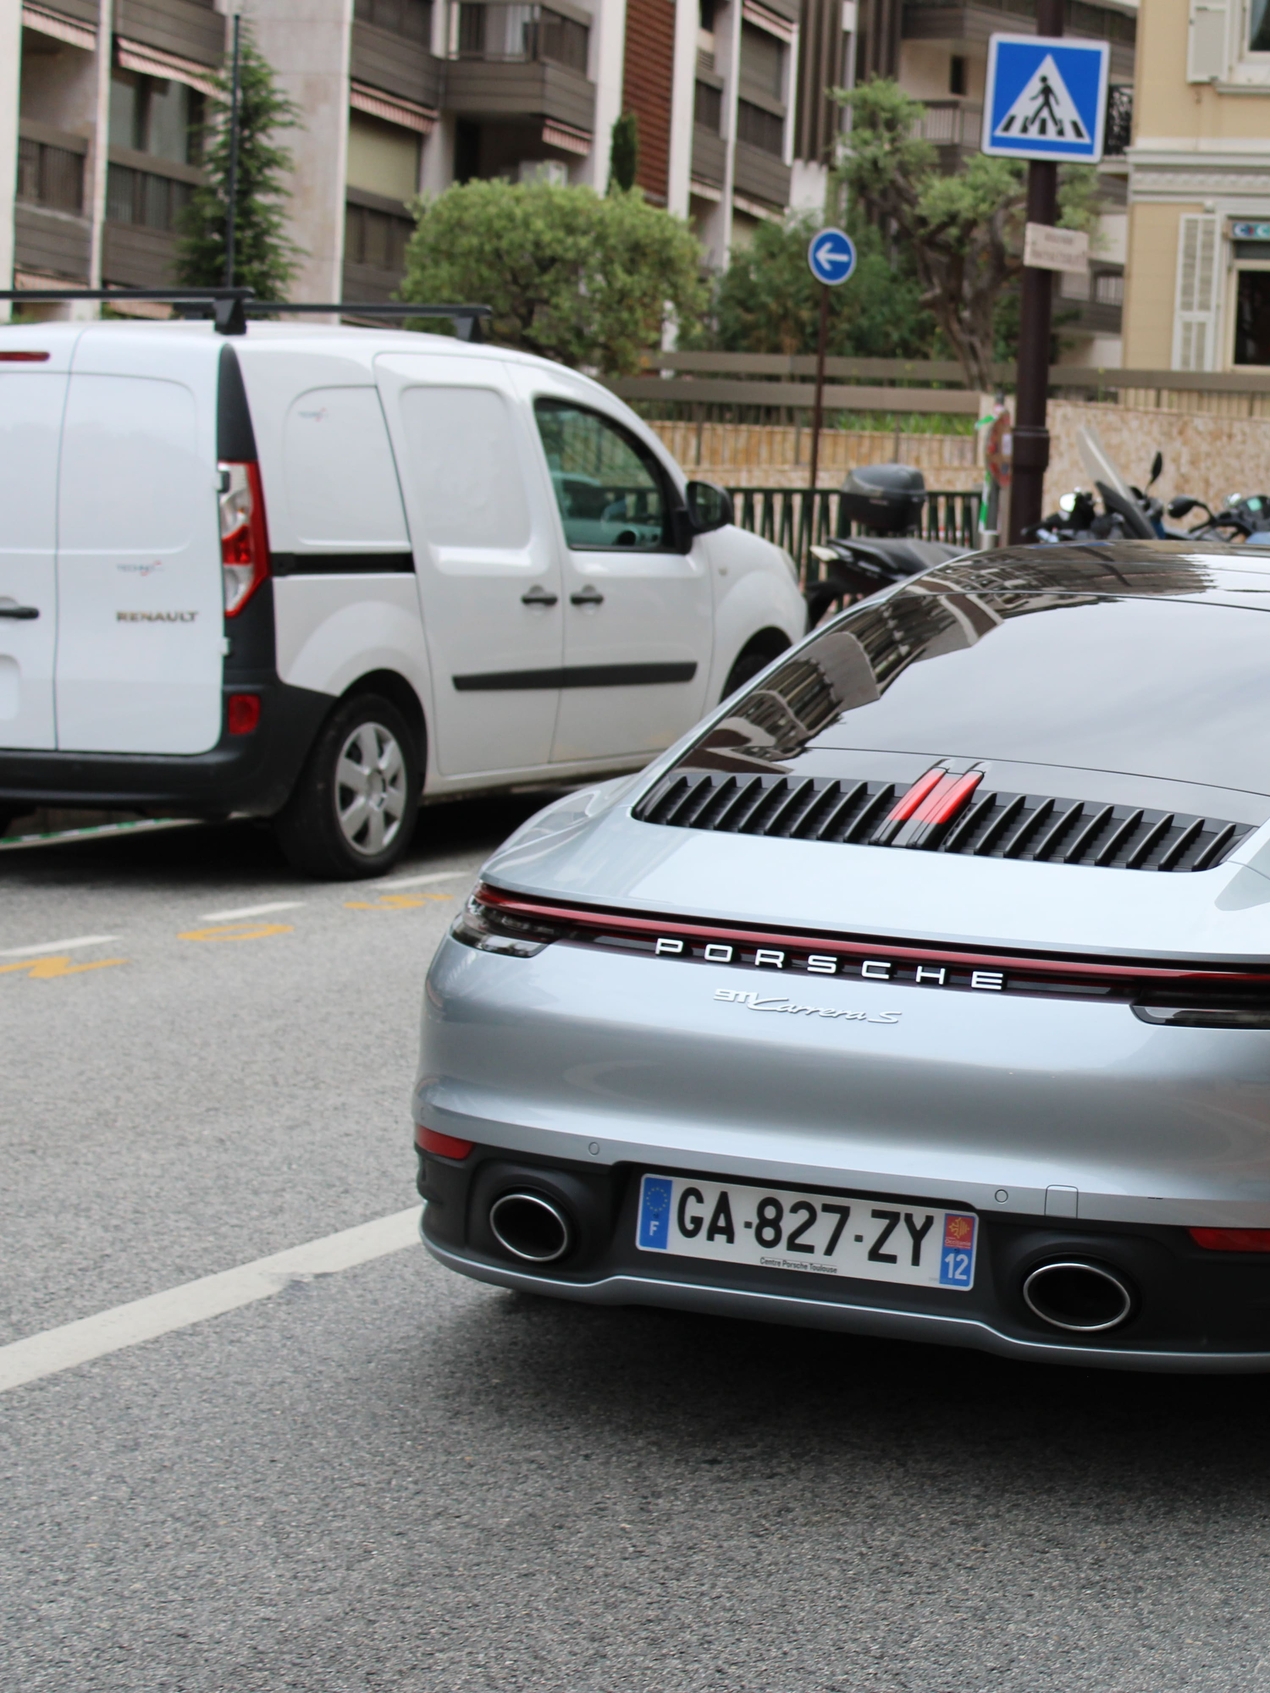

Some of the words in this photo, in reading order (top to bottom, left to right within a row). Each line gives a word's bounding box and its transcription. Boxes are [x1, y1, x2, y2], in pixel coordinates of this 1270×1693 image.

[116, 610, 198, 622] RENAULT
[655, 937, 1004, 990] PORSCHE
[713, 988, 758, 1003] 911
[747, 998, 866, 1021] Carrera
[868, 1011, 902, 1024] S
[649, 1220, 660, 1237] F
[677, 1187, 935, 1267] GA-827-ZY
[760, 1257, 781, 1267] Centre
[782, 1260, 808, 1270] Porsche
[810, 1263, 837, 1274] Toulouse
[944, 1253, 969, 1280] 12
